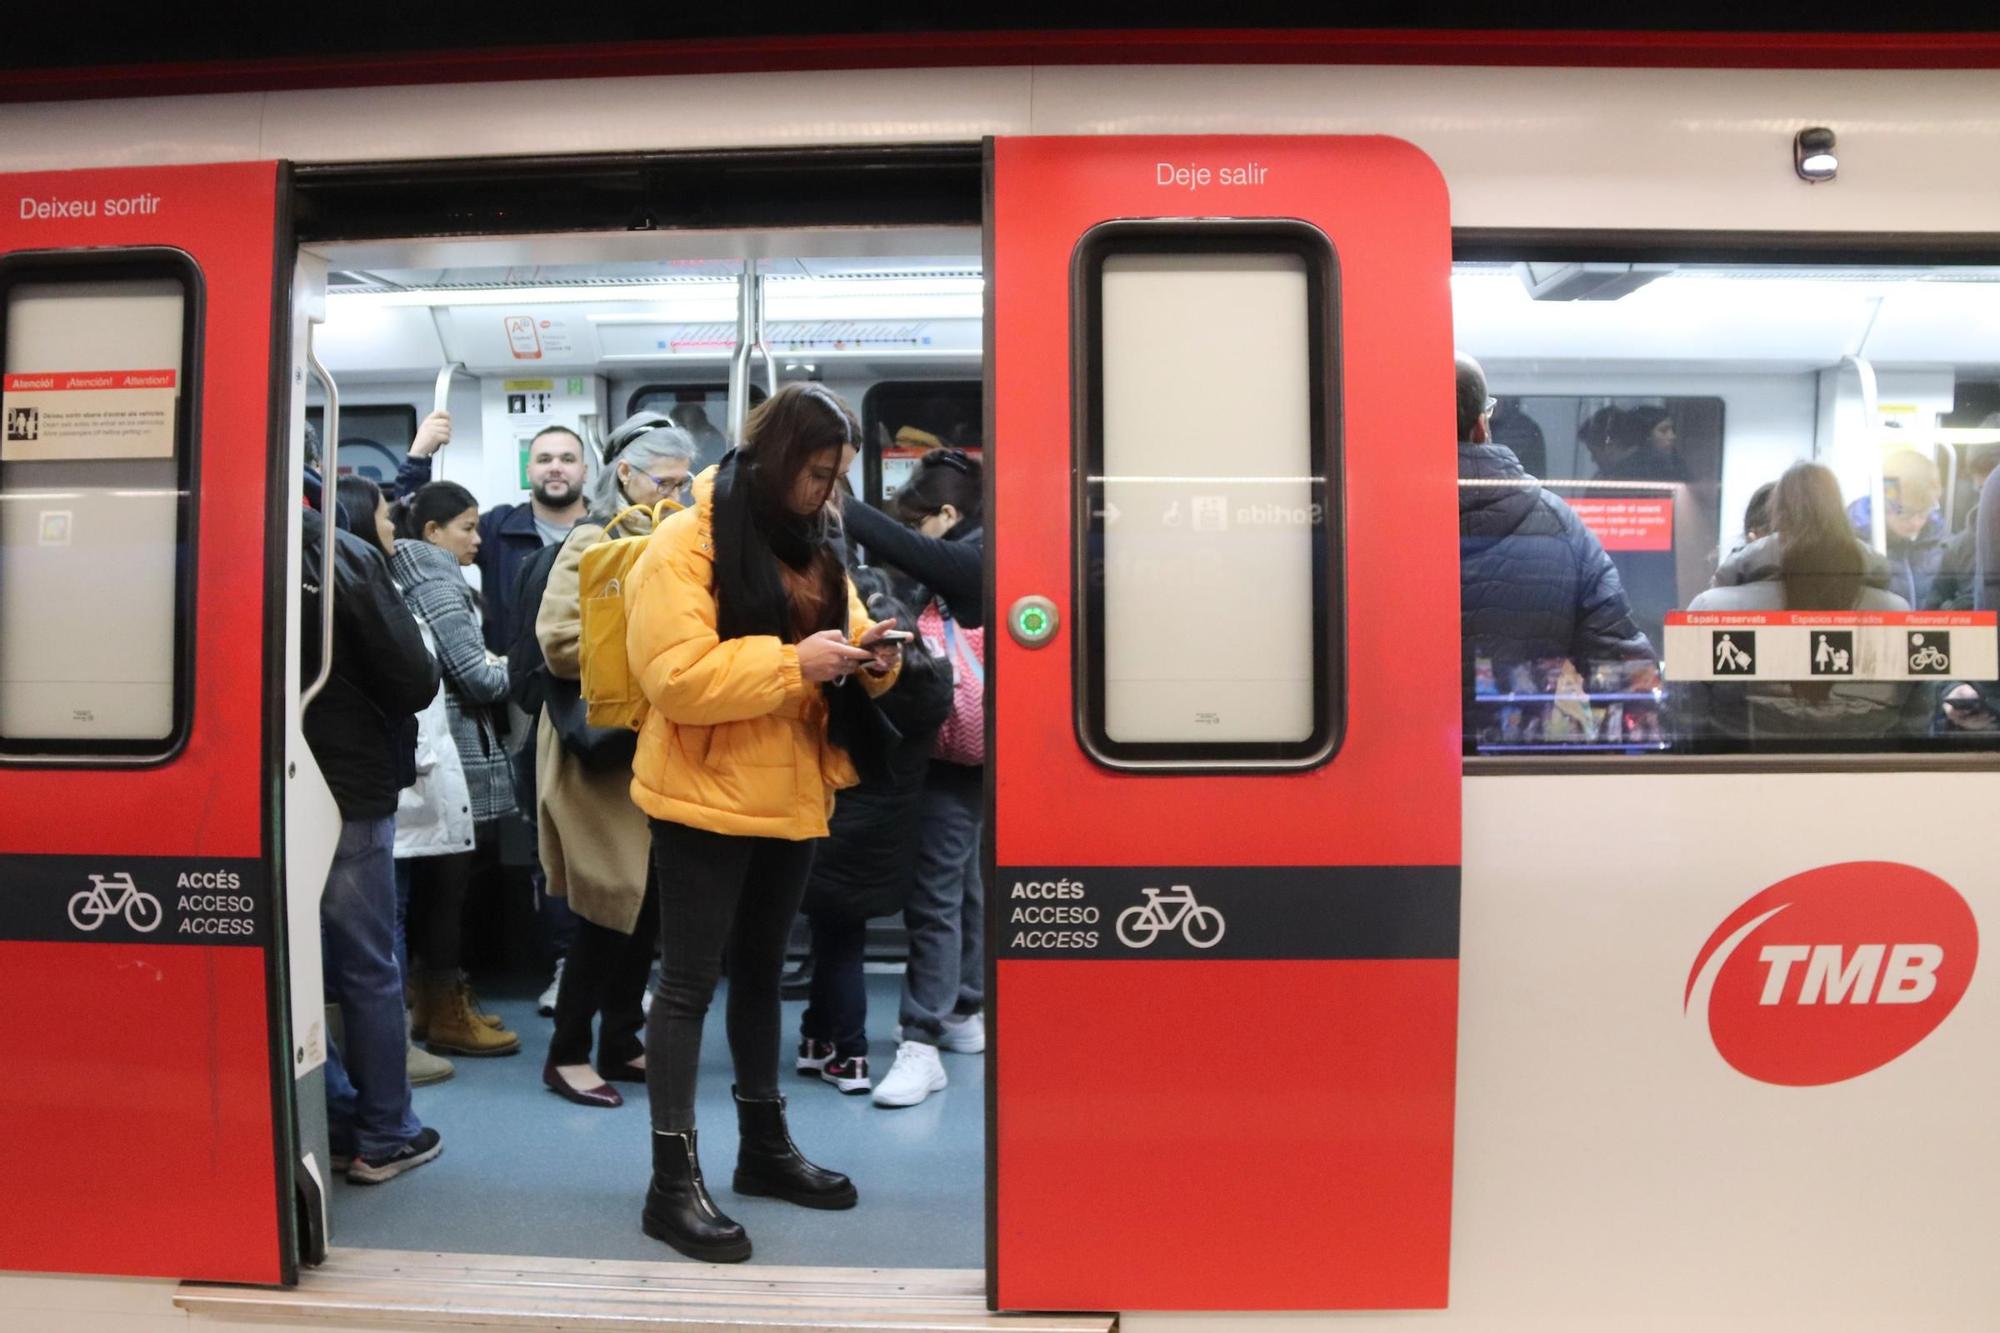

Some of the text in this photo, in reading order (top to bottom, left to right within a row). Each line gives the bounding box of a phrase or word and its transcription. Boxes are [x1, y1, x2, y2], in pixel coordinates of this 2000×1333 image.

[1156, 162, 1269, 191] Deje salir
[19, 192, 161, 220] Deixeu sortir
[123, 375, 170, 386] Attention!
[1791, 614, 1832, 625] Espacios
[176, 869, 241, 890] ACCÉS
[1010, 878, 1085, 900] ACCÉS
[177, 894, 255, 913] ACCESO
[1010, 906, 1100, 924] ACCESO
[178, 917, 255, 935] ACCESS
[1010, 931, 1100, 949] ACCESS
[1758, 943, 1945, 1006] TMB
